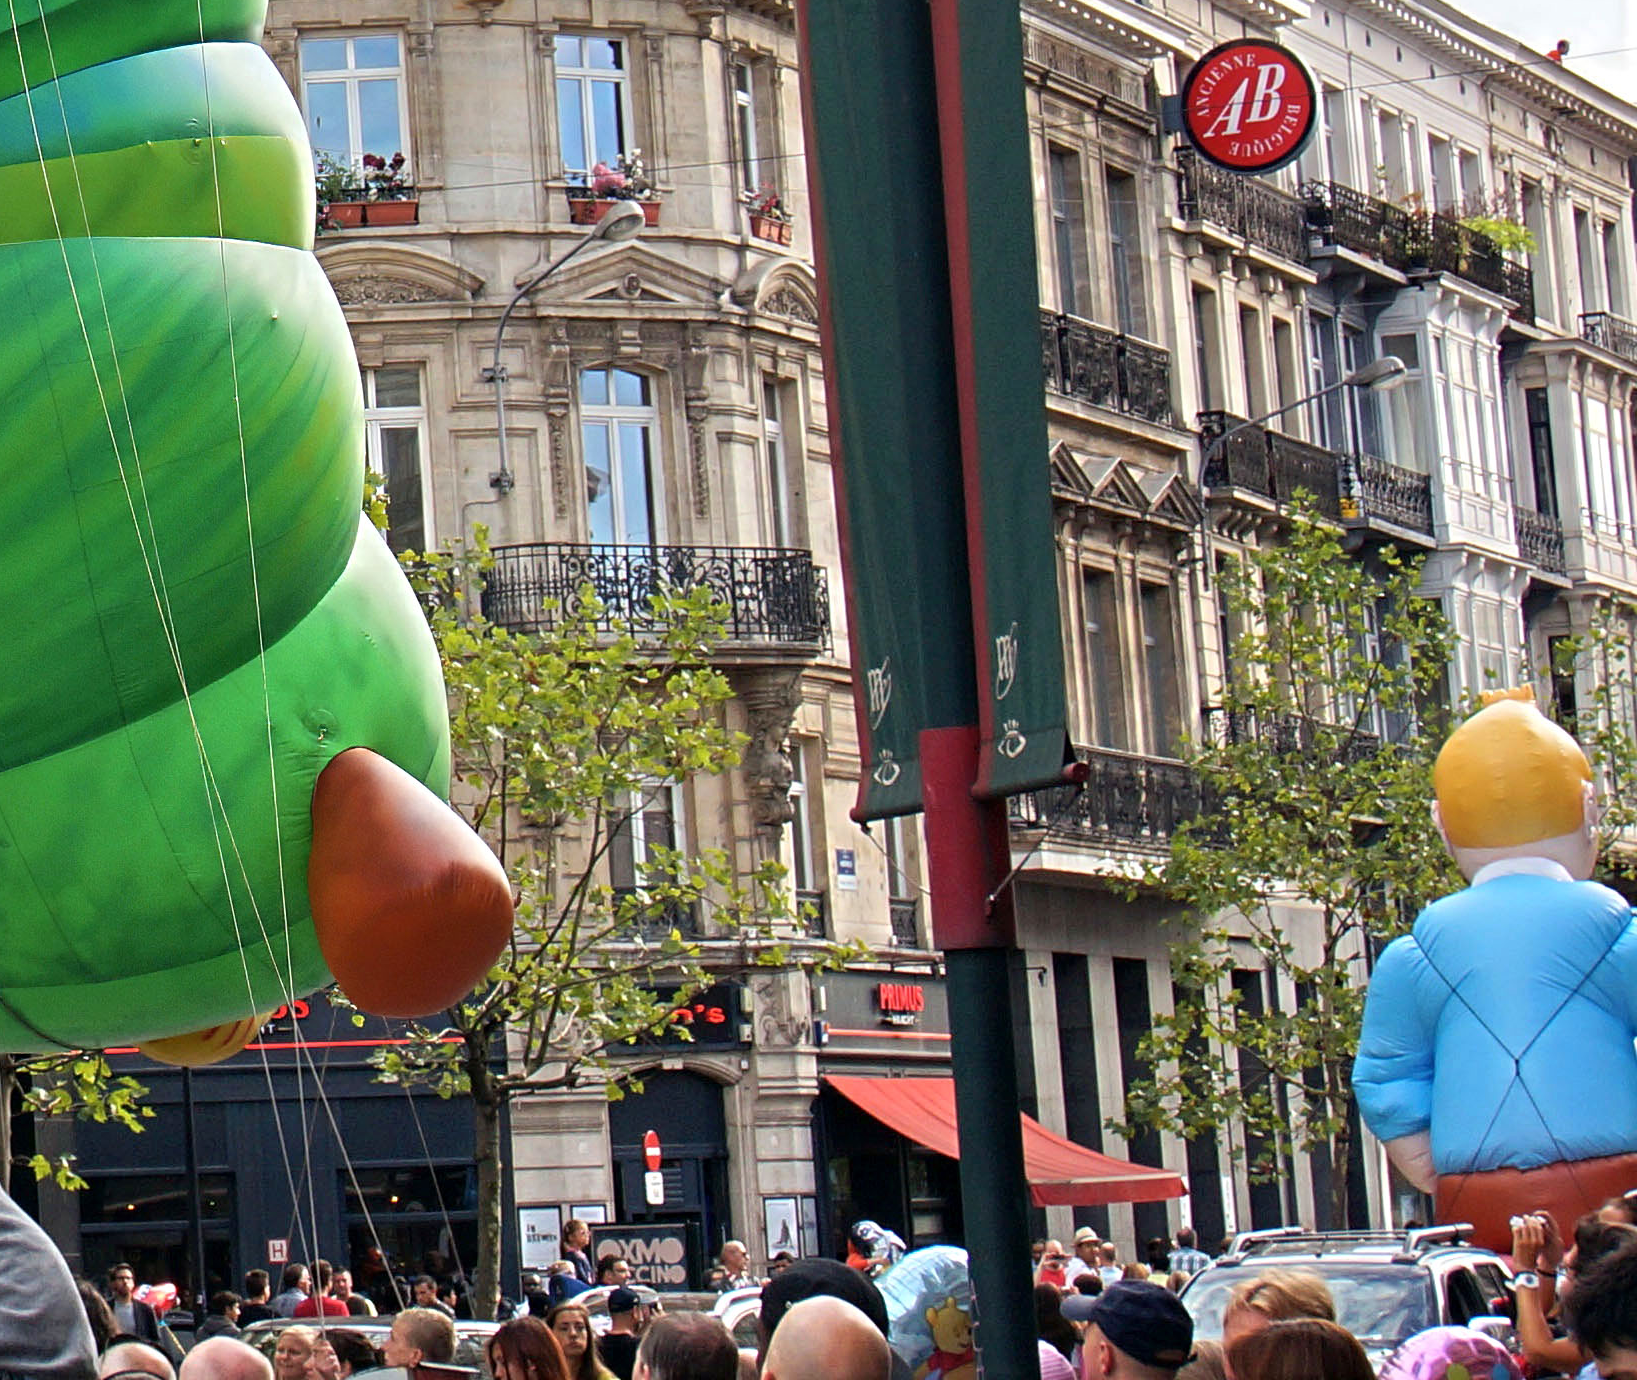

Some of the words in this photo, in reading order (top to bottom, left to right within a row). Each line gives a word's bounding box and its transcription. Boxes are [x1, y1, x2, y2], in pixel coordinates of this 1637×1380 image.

[1196, 53, 1256, 117] ANCIENNE
[1203, 63, 1285, 138] AB
[1229, 105, 1302, 157] BELGIQUE
[879, 983, 925, 1012] PRIMUS
[597, 1237, 684, 1265] OXMO
[627, 1265, 686, 1284] CCINO
